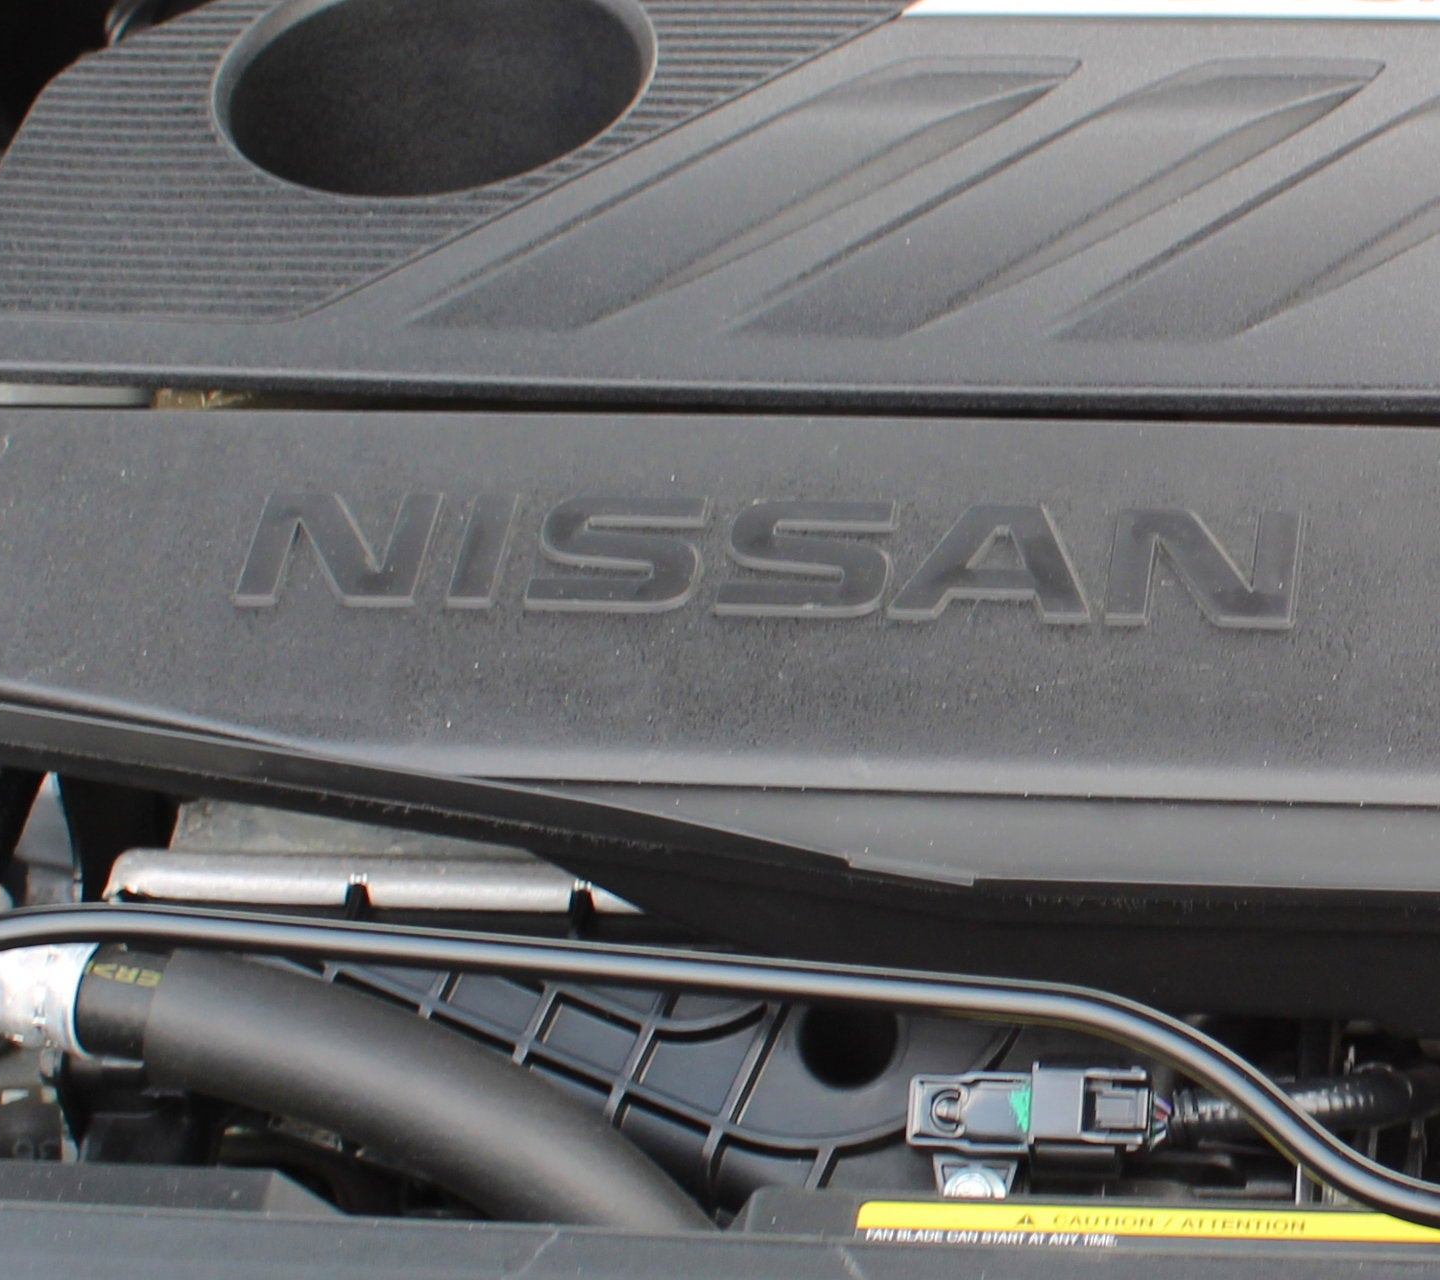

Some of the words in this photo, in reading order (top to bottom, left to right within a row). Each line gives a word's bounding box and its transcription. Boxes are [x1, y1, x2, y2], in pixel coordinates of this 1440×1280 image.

[233, 490, 1304, 631] NISSAN
[1053, 1214, 1155, 1231] CAUTION
[1180, 1216, 1307, 1235] ATTENTION
[865, 1228, 895, 1242] FAN
[896, 1228, 944, 1244] BLADE
[947, 1230, 979, 1245] CAN
[981, 1231, 1025, 1246] START
[1028, 1231, 1046, 1246] AT
[1048, 1232, 1079, 1247] ANY
